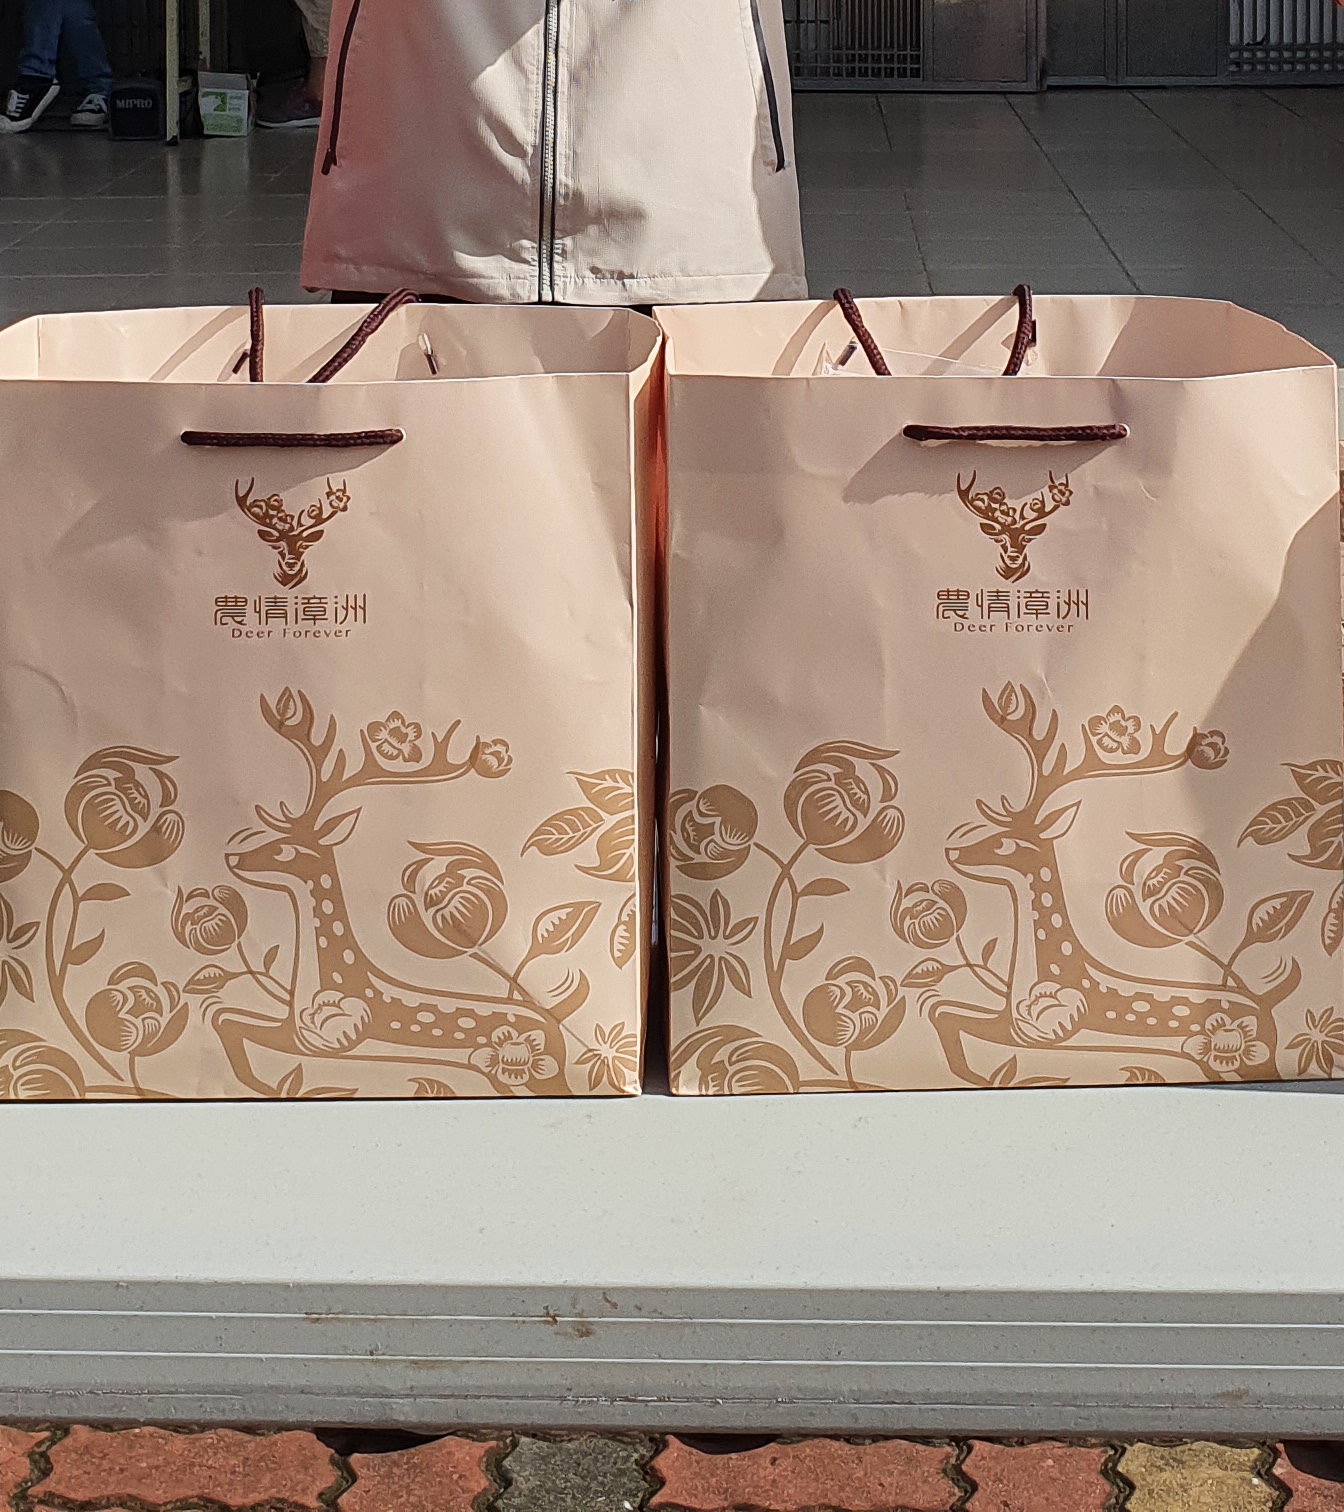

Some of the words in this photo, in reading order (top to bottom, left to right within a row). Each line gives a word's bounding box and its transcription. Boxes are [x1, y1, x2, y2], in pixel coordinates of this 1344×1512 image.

[213, 592, 368, 627] 農情漳洲
[935, 587, 1090, 621] 農情漳洲
[231, 627, 274, 639] Deer
[282, 627, 353, 639] Forever
[953, 621, 997, 633] Deer
[1004, 621, 1075, 633] Forever
